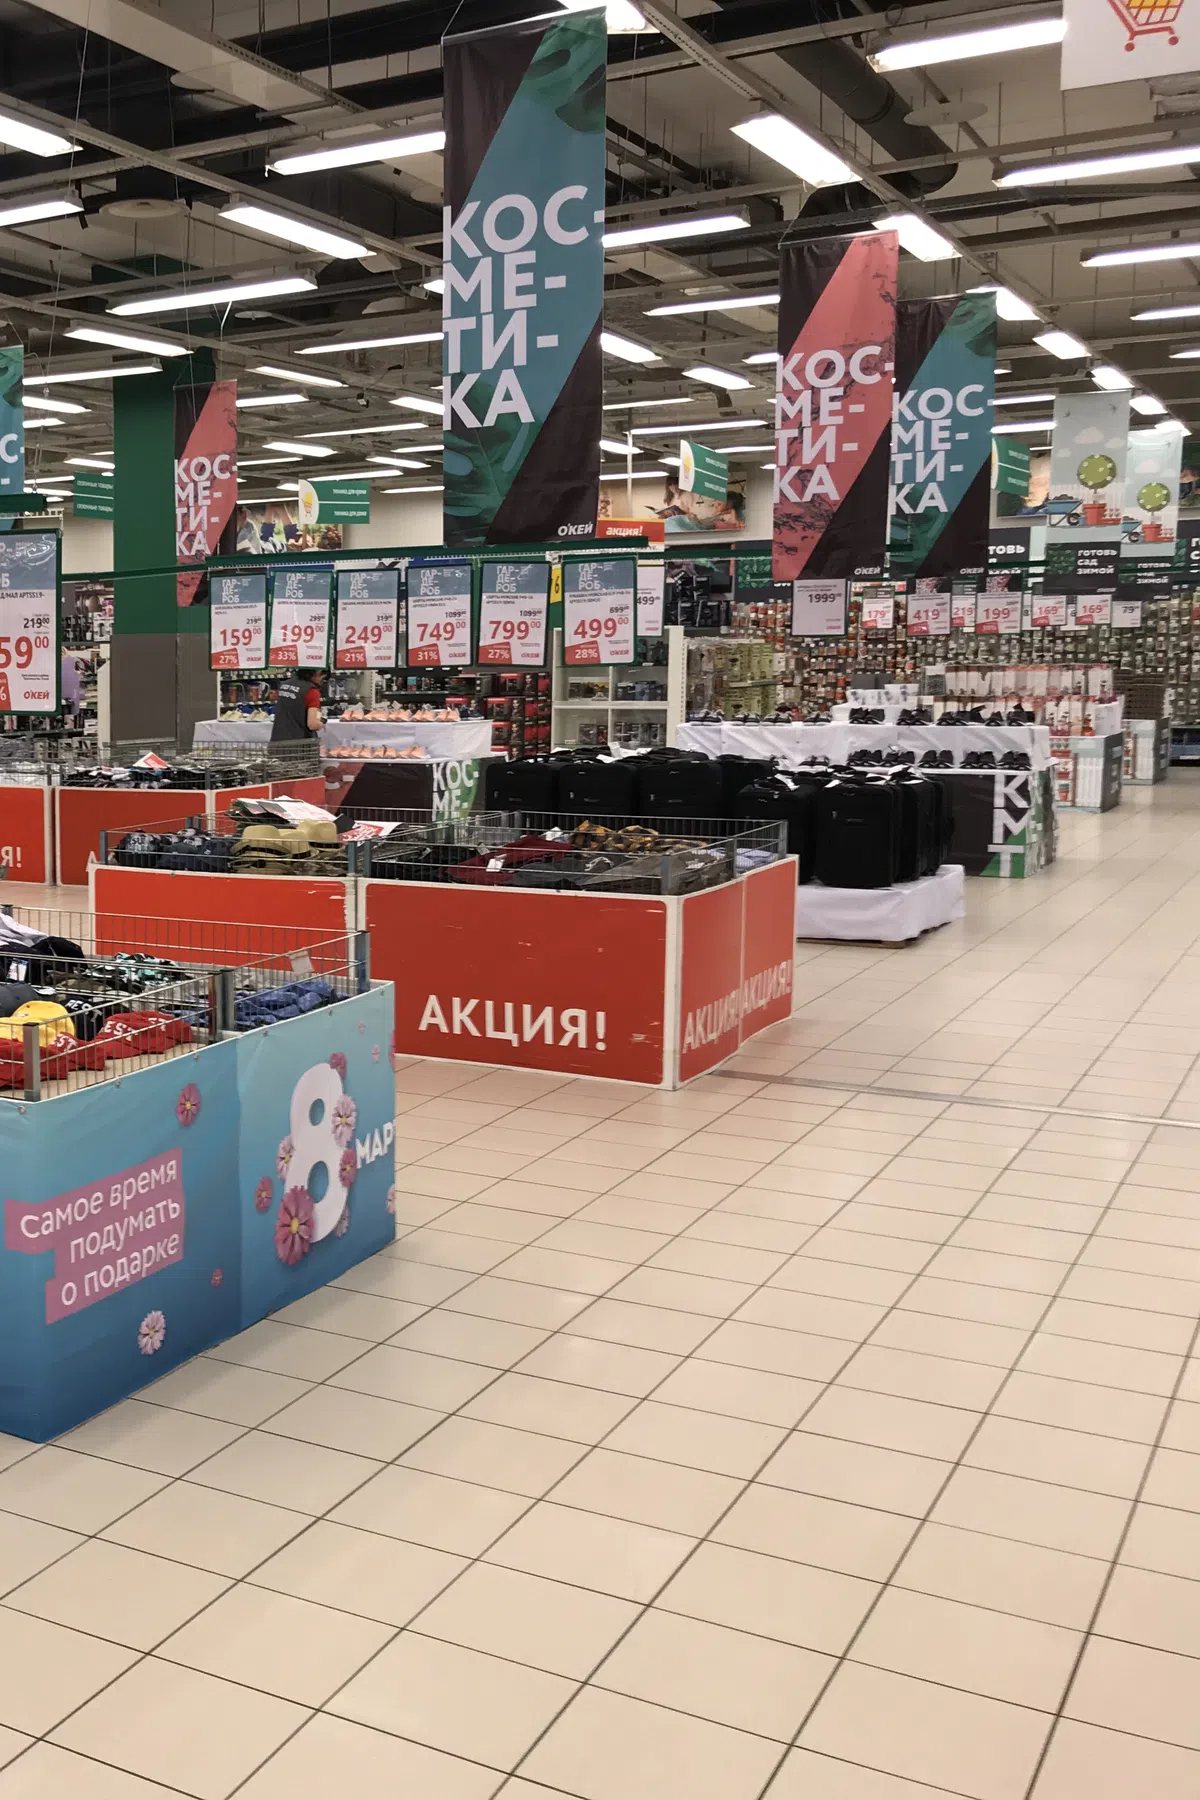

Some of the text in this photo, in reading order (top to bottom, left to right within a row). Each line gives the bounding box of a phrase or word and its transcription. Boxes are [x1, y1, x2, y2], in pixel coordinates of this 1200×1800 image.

[443, 184, 604, 261] КОС-
[443, 250, 567, 318] МЕ-
[443, 308, 559, 374] ТИ-
[776, 345, 895, 392] КОС-
[443, 368, 535, 431] КА
[775, 386, 865, 429] МЕ-
[890, 384, 995, 422] КОС-
[774, 426, 858, 466] ТИ-
[890, 418, 968, 454] МЕ-
[174, 454, 237, 483] КОС-
[890, 451, 963, 485] ТИ-
[174, 480, 222, 506] МЕ-
[773, 464, 840, 503] КА
[890, 483, 948, 516] КА
[175, 505, 220, 531] ТИ-
[606, 524, 643, 538] акция!
[176, 530, 211, 556] КА
[1076, 565, 1115, 574] зимой
[808, 593, 836, 603] 1999
[23, 618, 42, 629] 219
[913, 609, 940, 620] 419
[984, 608, 1010, 619] 199
[220, 628, 252, 646] 159
[281, 624, 314, 643] 199
[345, 625, 382, 644] 249
[416, 622, 455, 642] 749
[489, 621, 530, 640] 799
[574, 618, 617, 638] 499
[34, 636, 49, 648] 00
[488, 650, 509, 658] 27%
[575, 649, 597, 658] 28%
[219, 656, 237, 664] 27%
[277, 652, 296, 660] 33%
[344, 653, 364, 662] 21%
[417, 652, 438, 660] 31%
[432, 760, 479, 792] КОС-
[741, 959, 792, 1017] АКЦИЯ!
[418, 994, 608, 1051] АКЦИЯ!
[681, 988, 741, 1054] АКЦИЯ!
[285, 1062, 396, 1243] 8 МАР
[20, 1158, 178, 1239] самое время
[70, 1199, 181, 1263] подумать
[61, 1233, 180, 1306] о подарке
